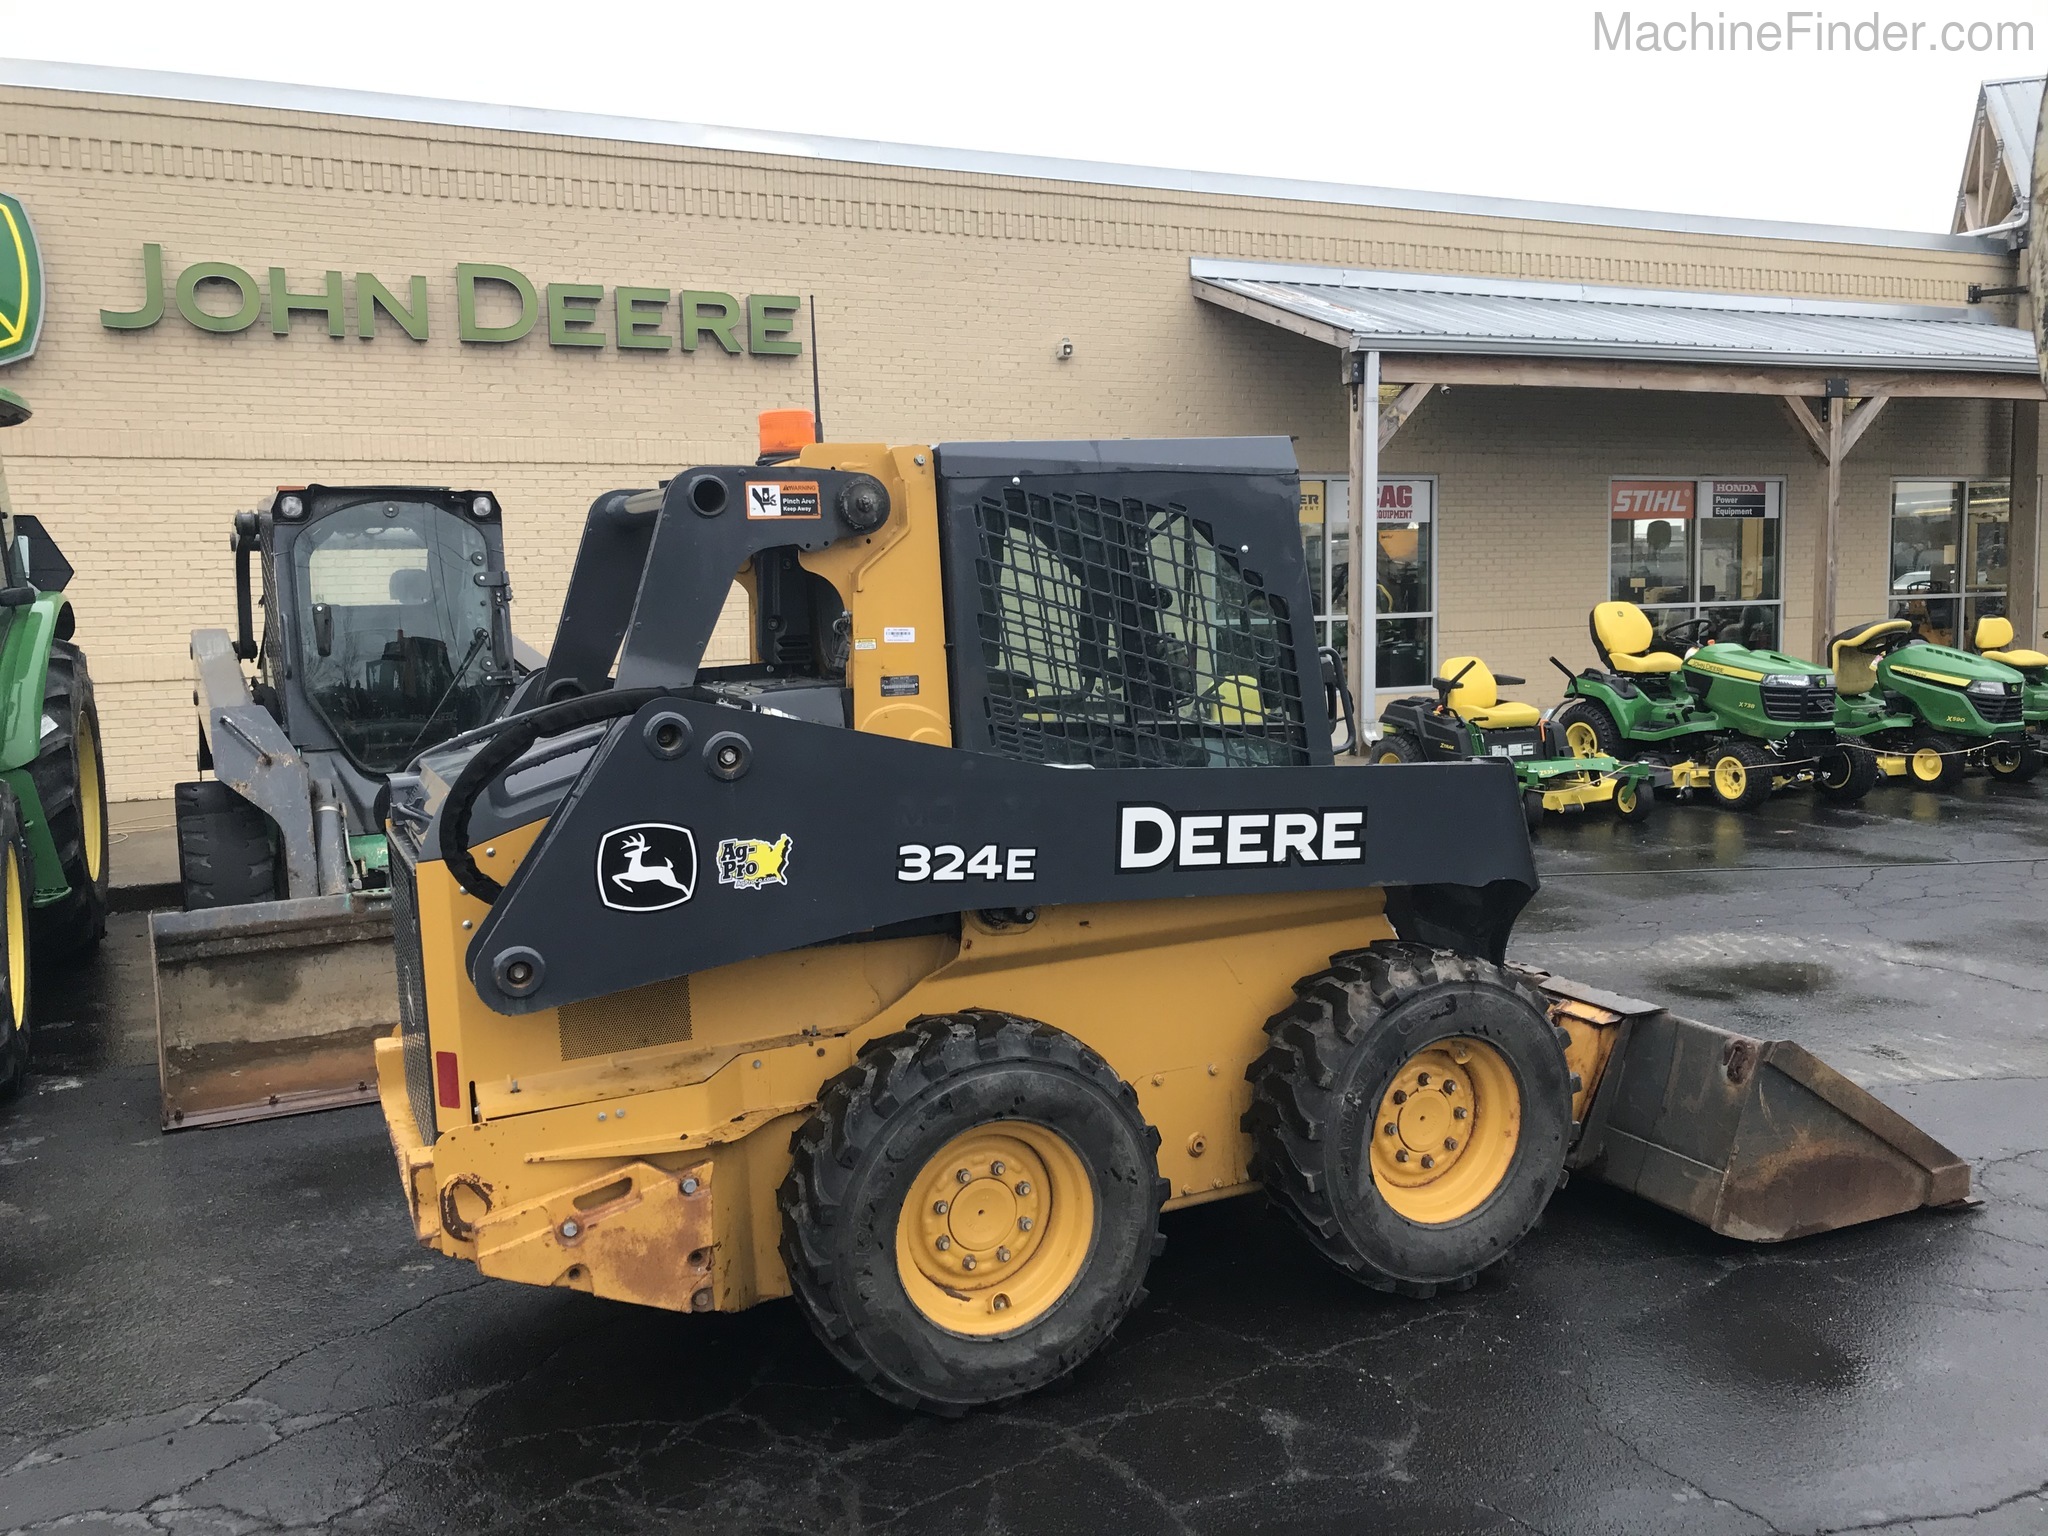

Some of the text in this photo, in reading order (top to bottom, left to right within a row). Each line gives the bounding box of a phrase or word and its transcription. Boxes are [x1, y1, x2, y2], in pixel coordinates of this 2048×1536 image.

[100, 243, 802, 355] JOHN DEERE
[1717, 484, 1758, 492] HONDA
[1715, 496, 1738, 504] Power
[1715, 507, 1752, 516] Equipment
[1706, 663, 1725, 674] DEERE
[1120, 806, 1363, 869] DEERE
[720, 842, 757, 863] Ag-
[898, 844, 1037, 881] 324E
[722, 860, 758, 880] Pro
